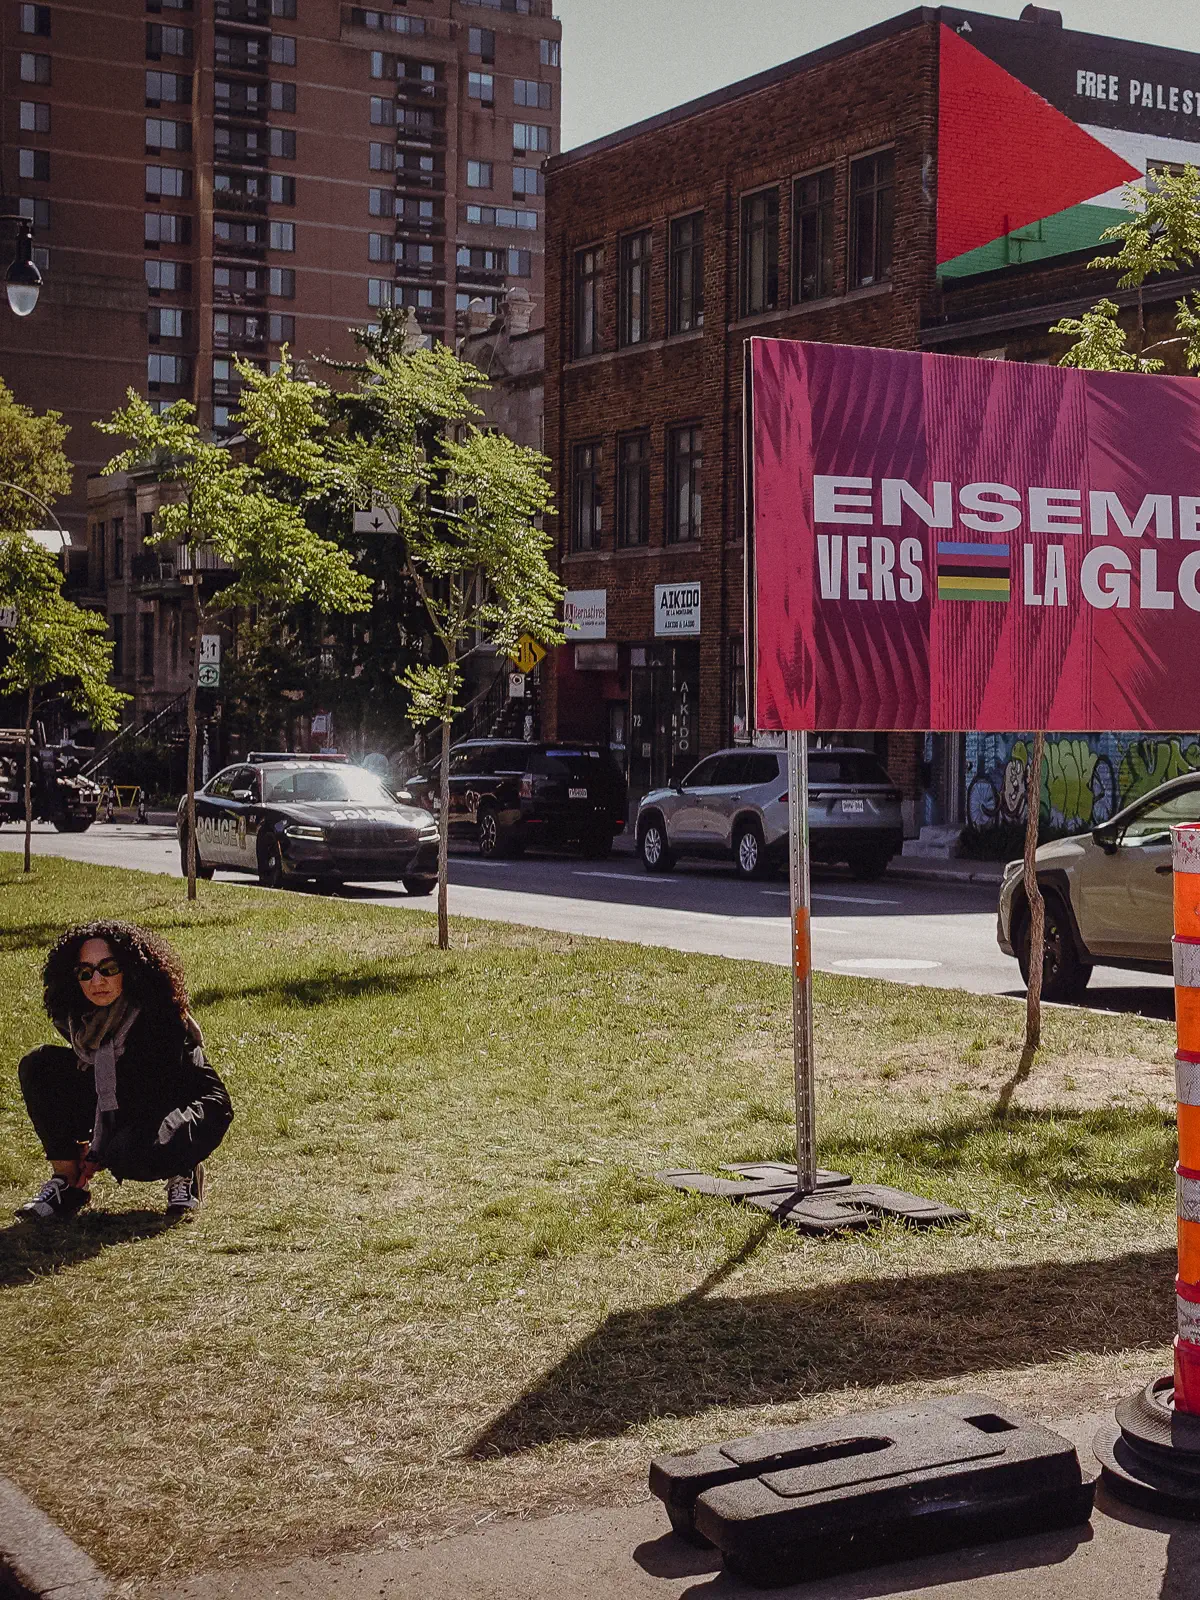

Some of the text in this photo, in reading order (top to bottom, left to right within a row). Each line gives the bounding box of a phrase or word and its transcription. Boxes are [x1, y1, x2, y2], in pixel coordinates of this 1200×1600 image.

[1076, 70, 1119, 101] FREE
[816, 534, 923, 603] VERS
[1023, 543, 1068, 607] LA
[660, 589, 700, 610] AIKIDO
[679, 681, 689, 751] AIKIDO
[197, 816, 239, 847] POLICE
